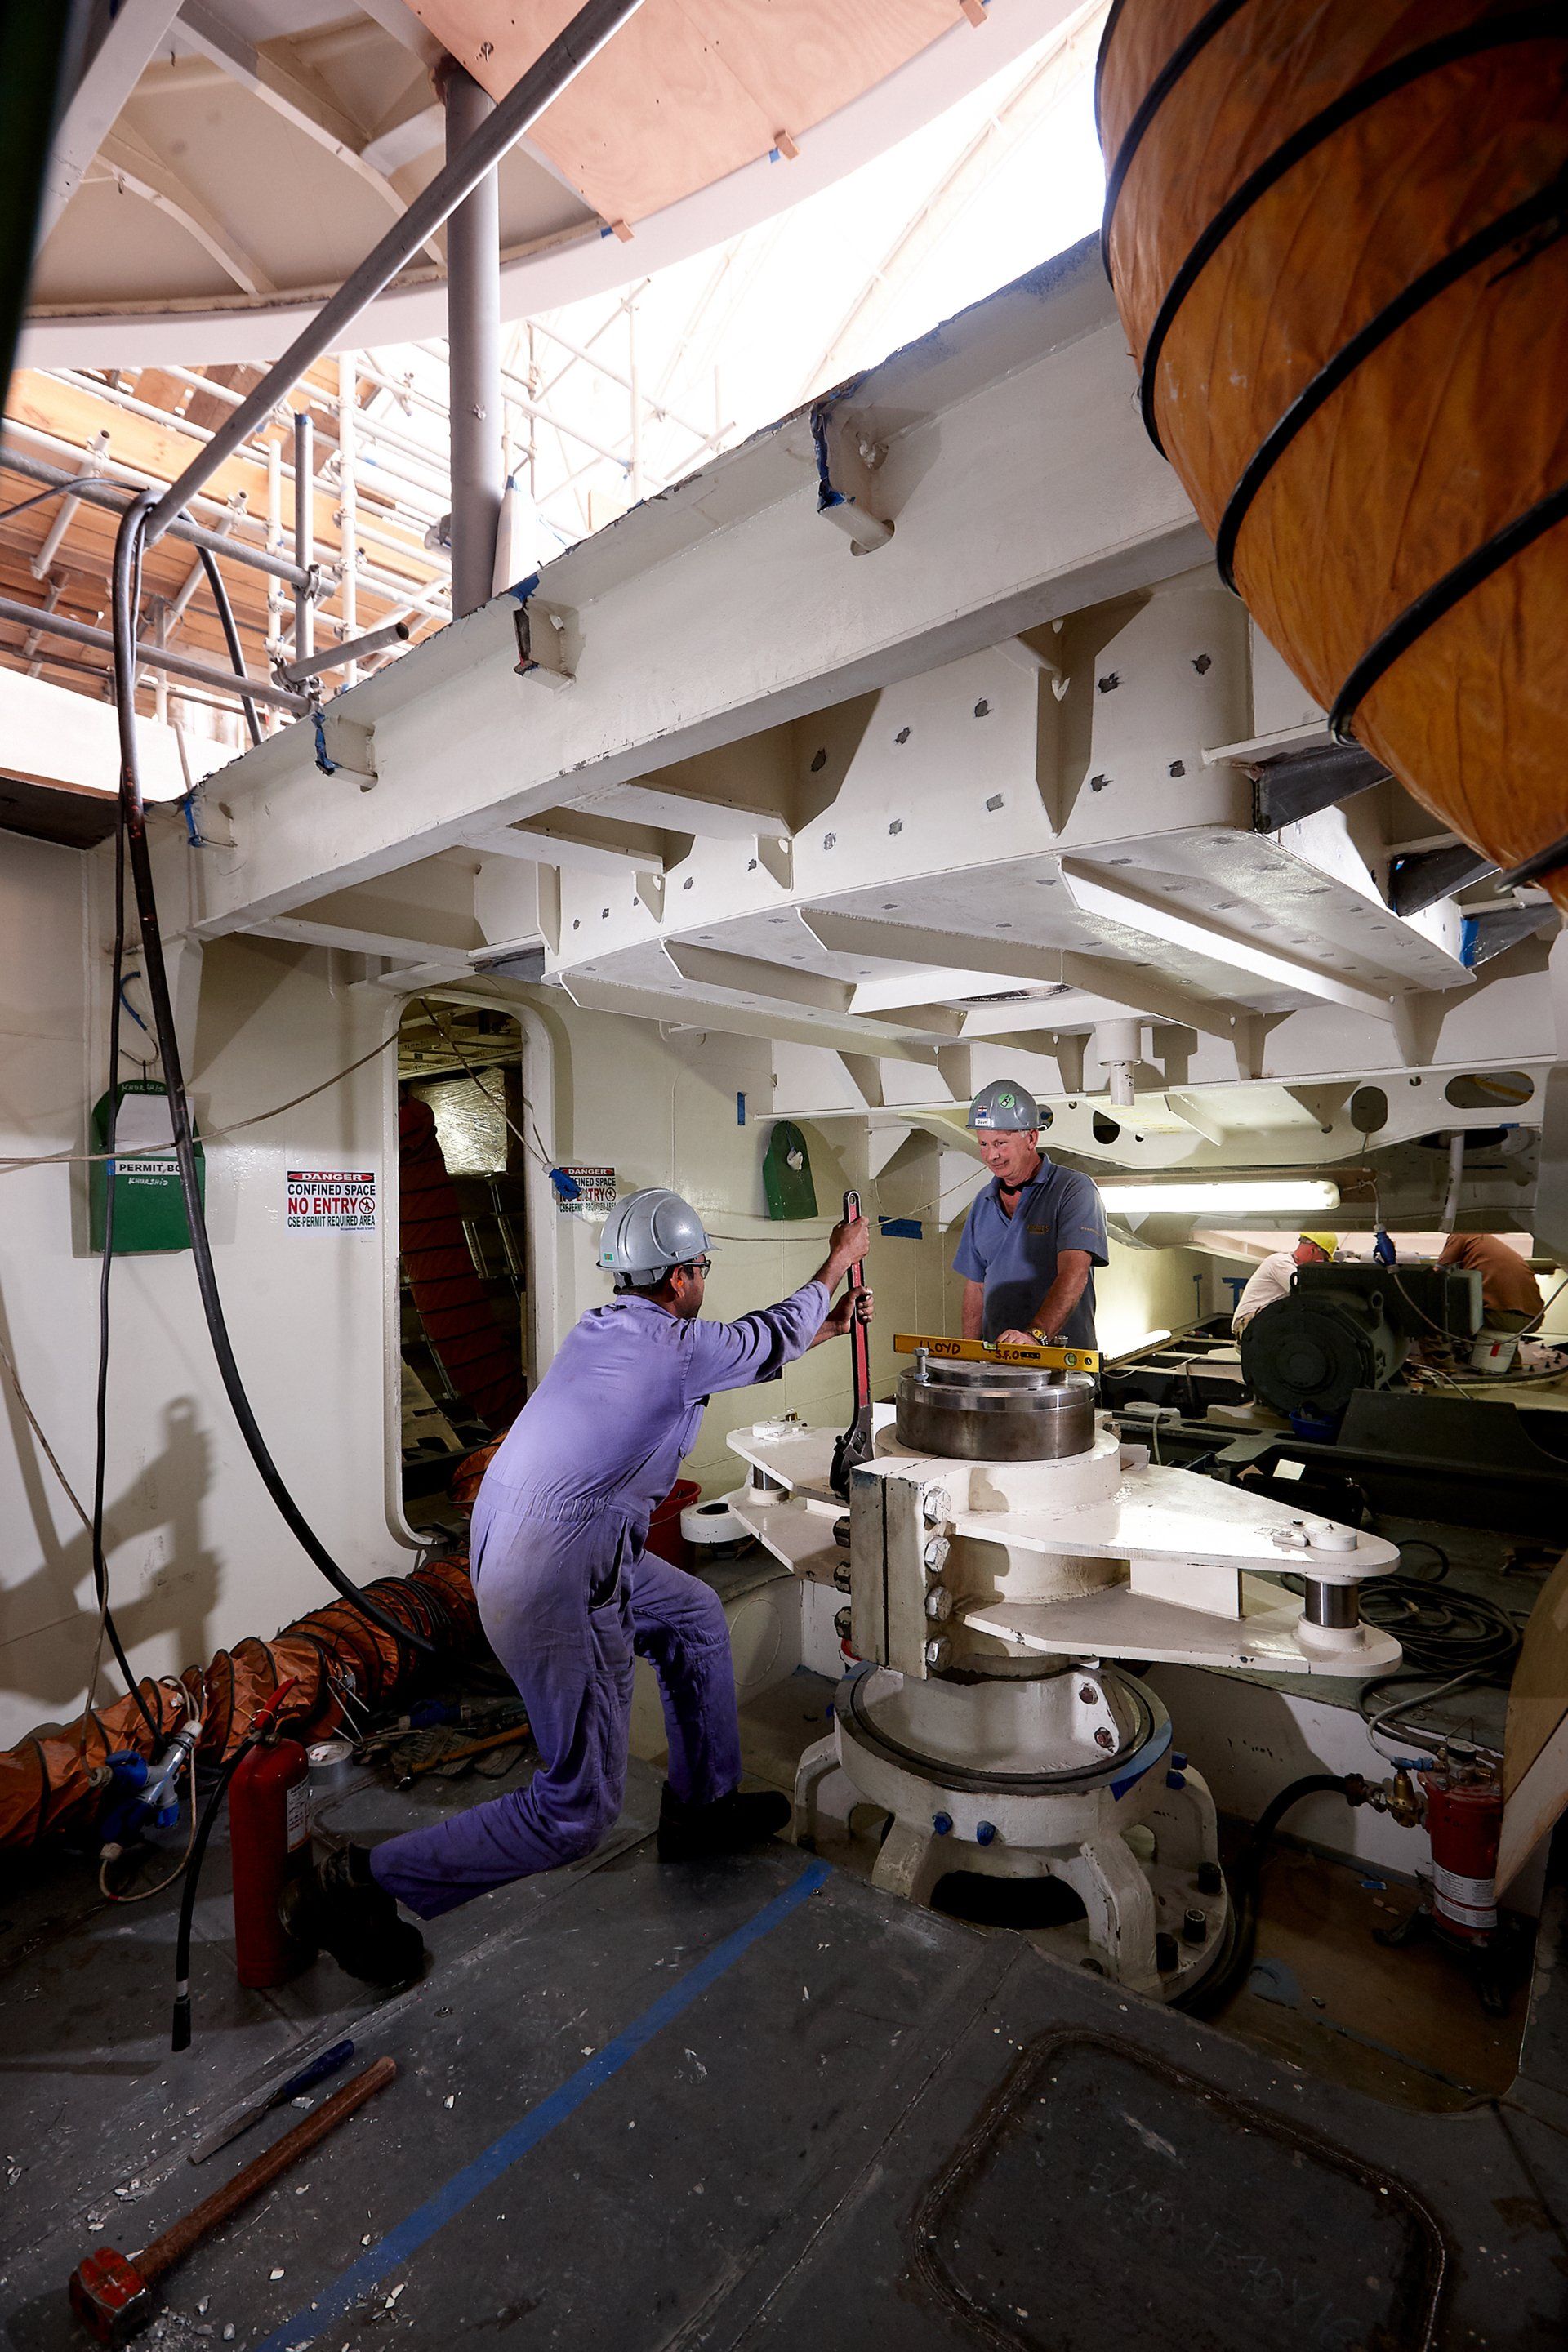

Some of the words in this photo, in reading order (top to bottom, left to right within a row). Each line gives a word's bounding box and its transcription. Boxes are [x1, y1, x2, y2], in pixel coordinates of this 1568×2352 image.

[119, 1164, 163, 1172] PERMIT
[301, 1173, 363, 1181] DANGER
[595, 1177, 616, 1187] SPACE
[287, 1184, 341, 1195] CONFINED
[345, 1184, 376, 1196] SPACE
[288, 1197, 309, 1214] NO
[314, 1197, 358, 1214] ENTRY
[287, 1216, 326, 1227] CSE-PERMIT
[327, 1215, 358, 1227] REQUIRED
[359, 1215, 376, 1226] AREA
